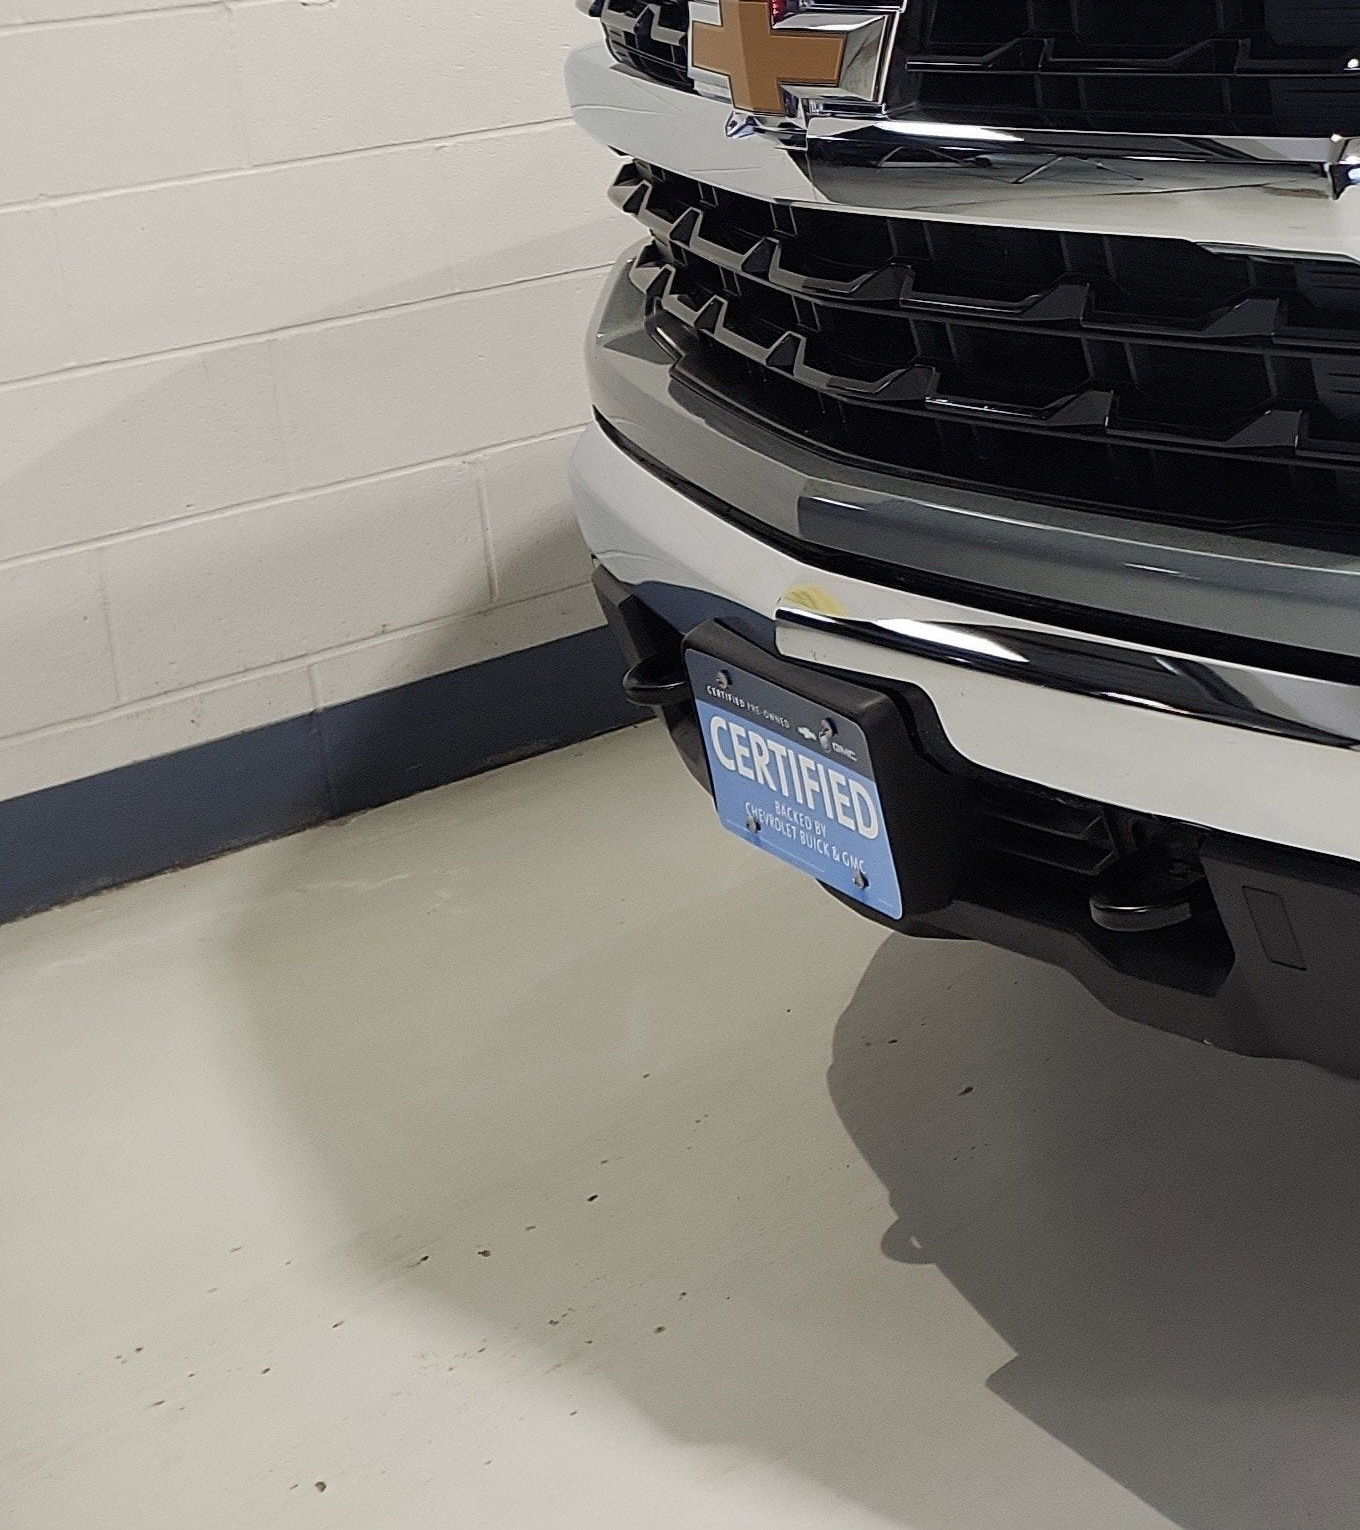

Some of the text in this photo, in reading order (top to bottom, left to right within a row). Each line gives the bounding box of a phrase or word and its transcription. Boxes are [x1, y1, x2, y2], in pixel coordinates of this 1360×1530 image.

[706, 684, 745, 708] CERTIFIED
[710, 715, 879, 840] CERTIFIED
[745, 801, 867, 875] CHEVROLET BUICK & GMC
[774, 800, 827, 837] BACKED BY
